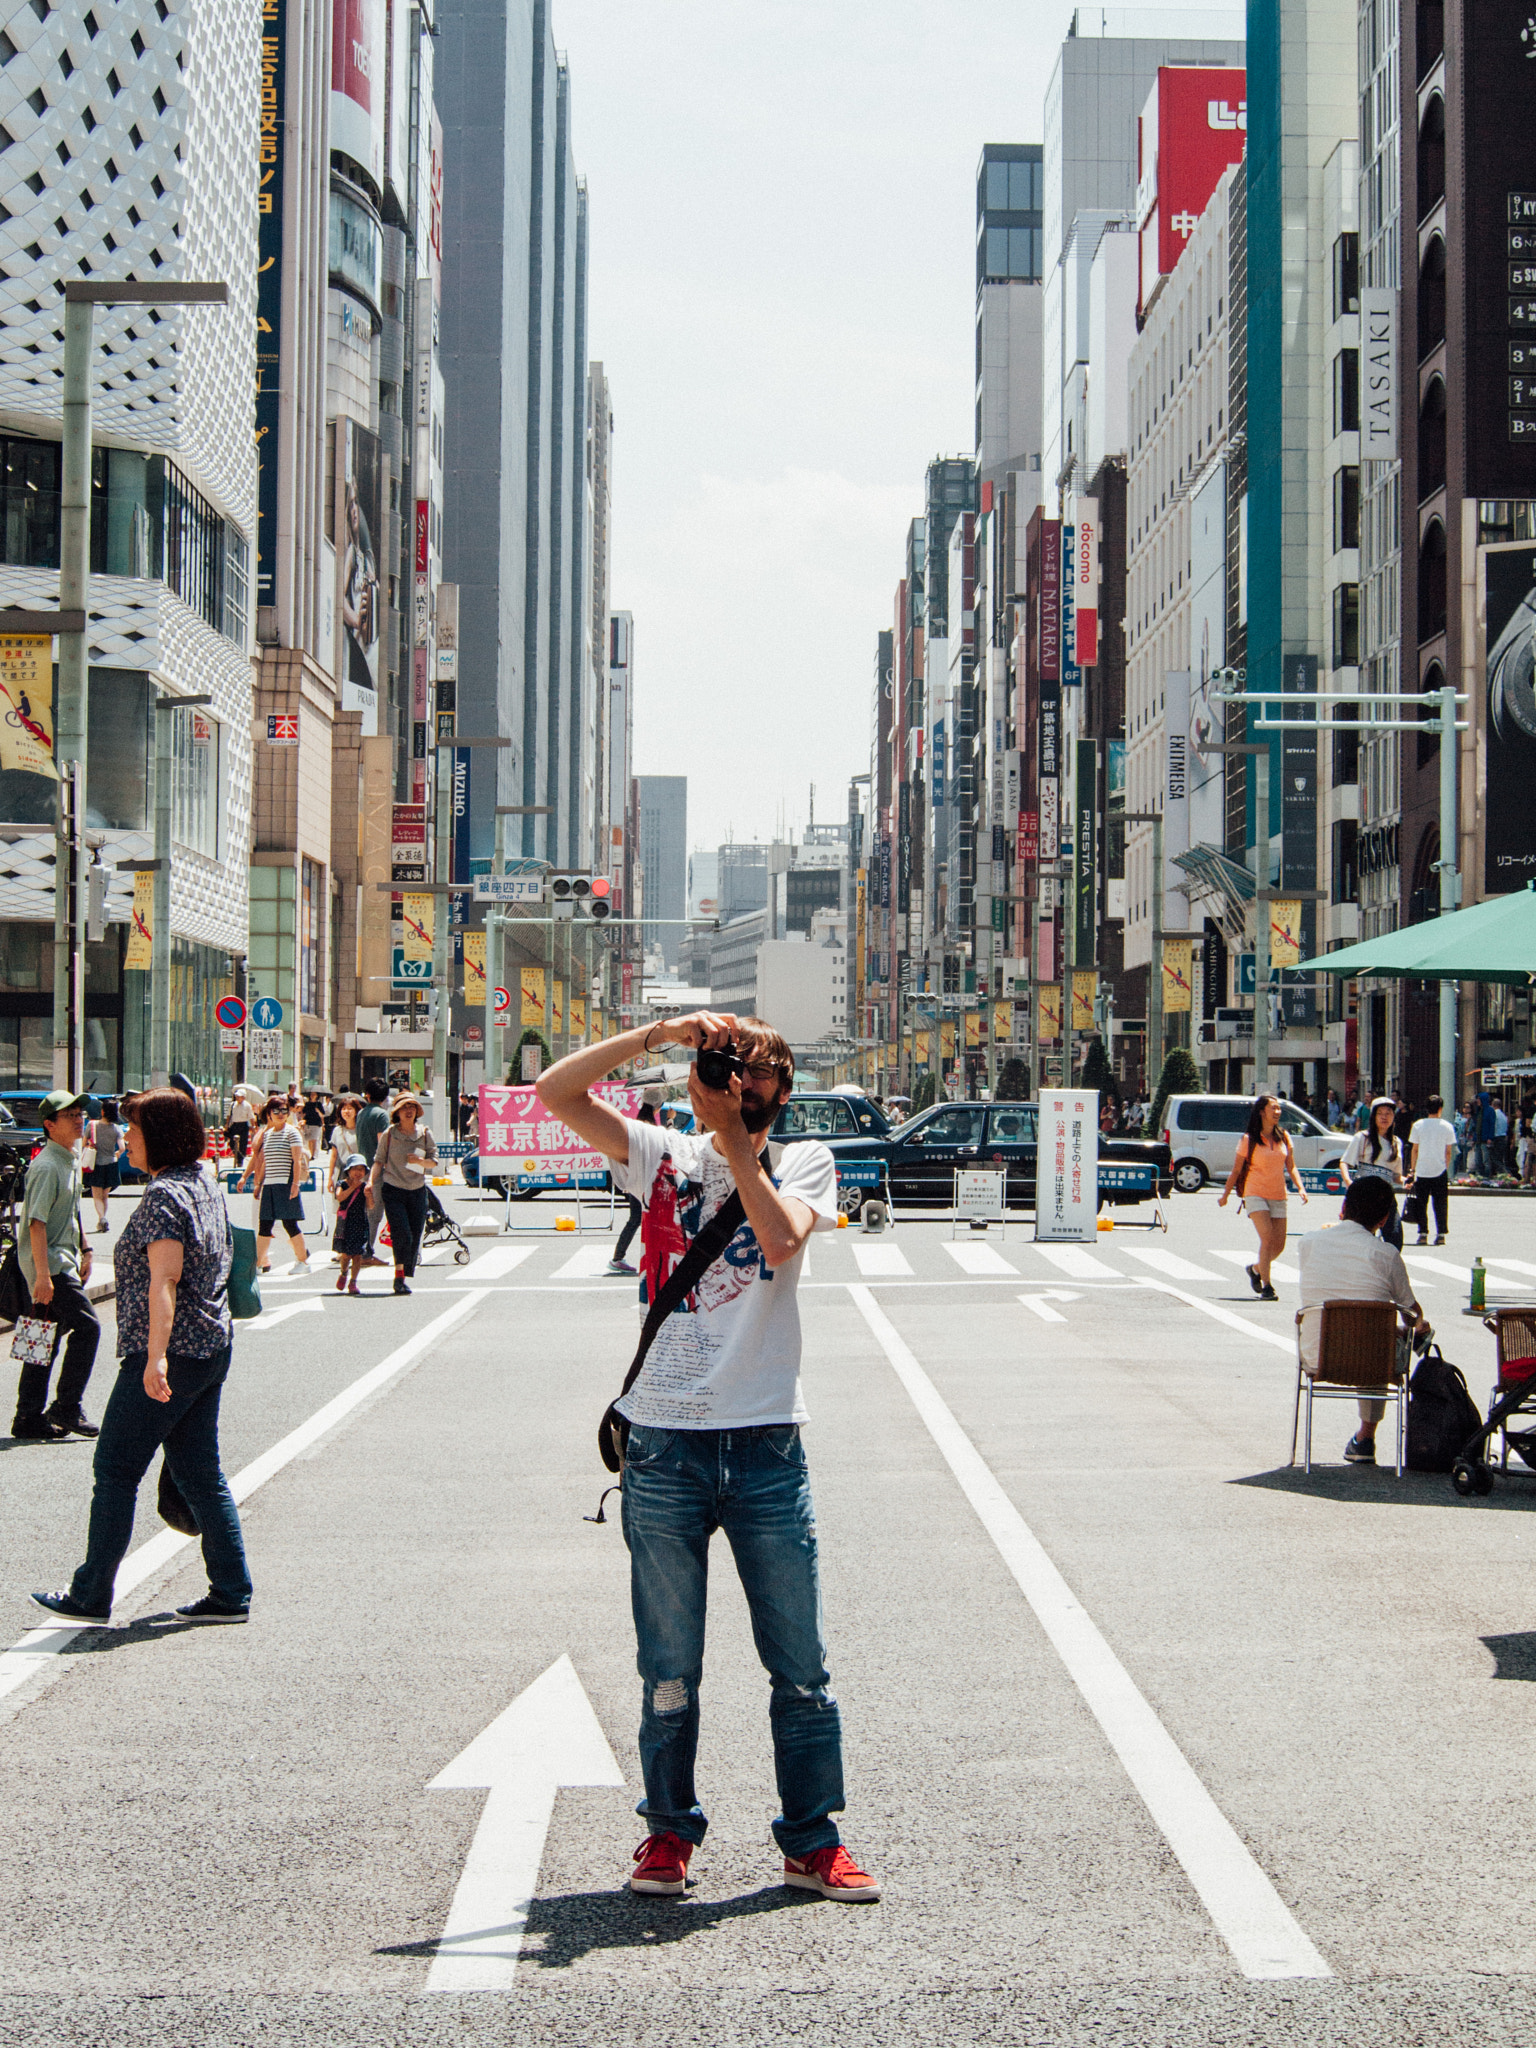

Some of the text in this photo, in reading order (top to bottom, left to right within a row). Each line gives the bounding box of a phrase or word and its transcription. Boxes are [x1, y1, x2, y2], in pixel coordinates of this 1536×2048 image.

[1512, 236, 1522, 248] 6
[1513, 271, 1522, 283] 5
[1513, 306, 1524, 318] 4
[1513, 350, 1524, 362] 3
[1369, 309, 1390, 441] TASAKI
[1512, 420, 1524, 433] B
[1081, 522, 1093, 584] docomo
[1043, 590, 1057, 668] NATARAJ
[1065, 671, 1080, 680] 6F
[1042, 701, 1057, 710] 6F
[269, 718, 275, 736] 6F
[1169, 735, 1186, 801] EXITMELSA
[455, 762, 466, 816] MIZUHO
[1021, 813, 1037, 822] ユニ
[1021, 822, 1037, 831] クロ
[1020, 839, 1037, 848] UNI
[1020, 848, 1037, 857] QLO
[478, 881, 539, 894] 銀座四丁目
[496, 893, 514, 901] Ginza
[1209, 934, 1217, 1003] WASHINGTON
[1054, 1101, 1084, 1113] 警告
[540, 1155, 604, 1171] スマイル党
[1072, 1120, 1082, 1204] 道路上での人寄せ行為
